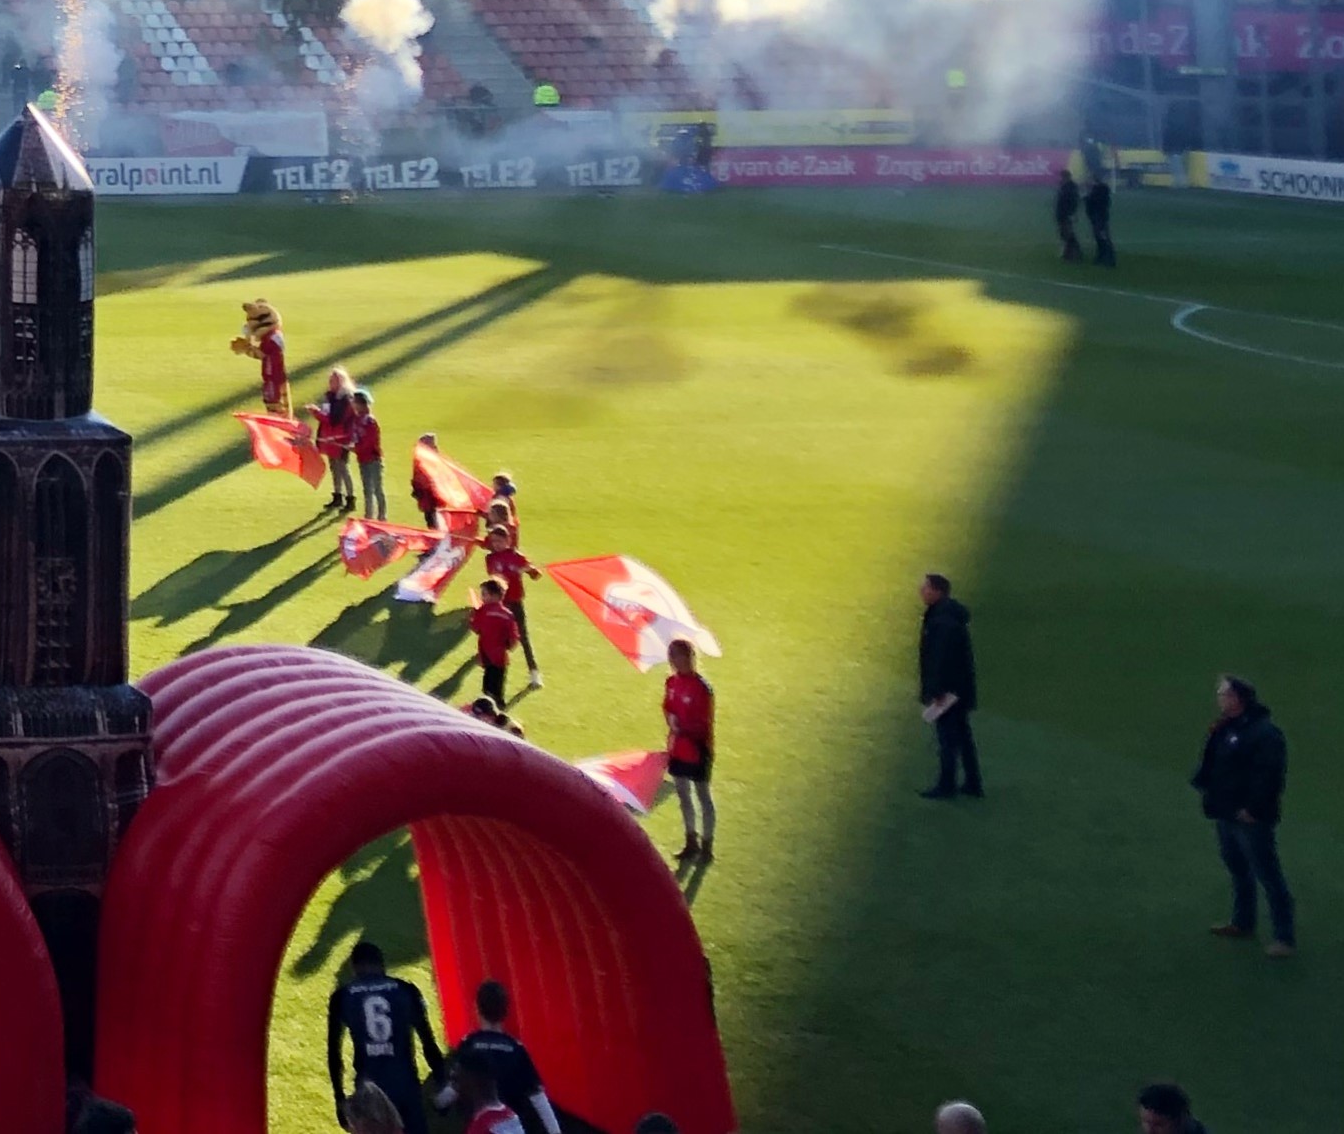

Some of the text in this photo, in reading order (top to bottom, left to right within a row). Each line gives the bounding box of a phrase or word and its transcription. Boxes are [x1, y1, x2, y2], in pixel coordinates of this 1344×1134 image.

[272, 158, 351, 191] TELE2
[362, 157, 440, 191] TELE2
[459, 156, 537, 188] TELE2
[565, 155, 643, 187] TELE2
[803, 155, 857, 176] Zaak
[876, 154, 927, 182] Zorg
[998, 154, 1051, 176] Zaak
[362, 995, 394, 1044] 6
